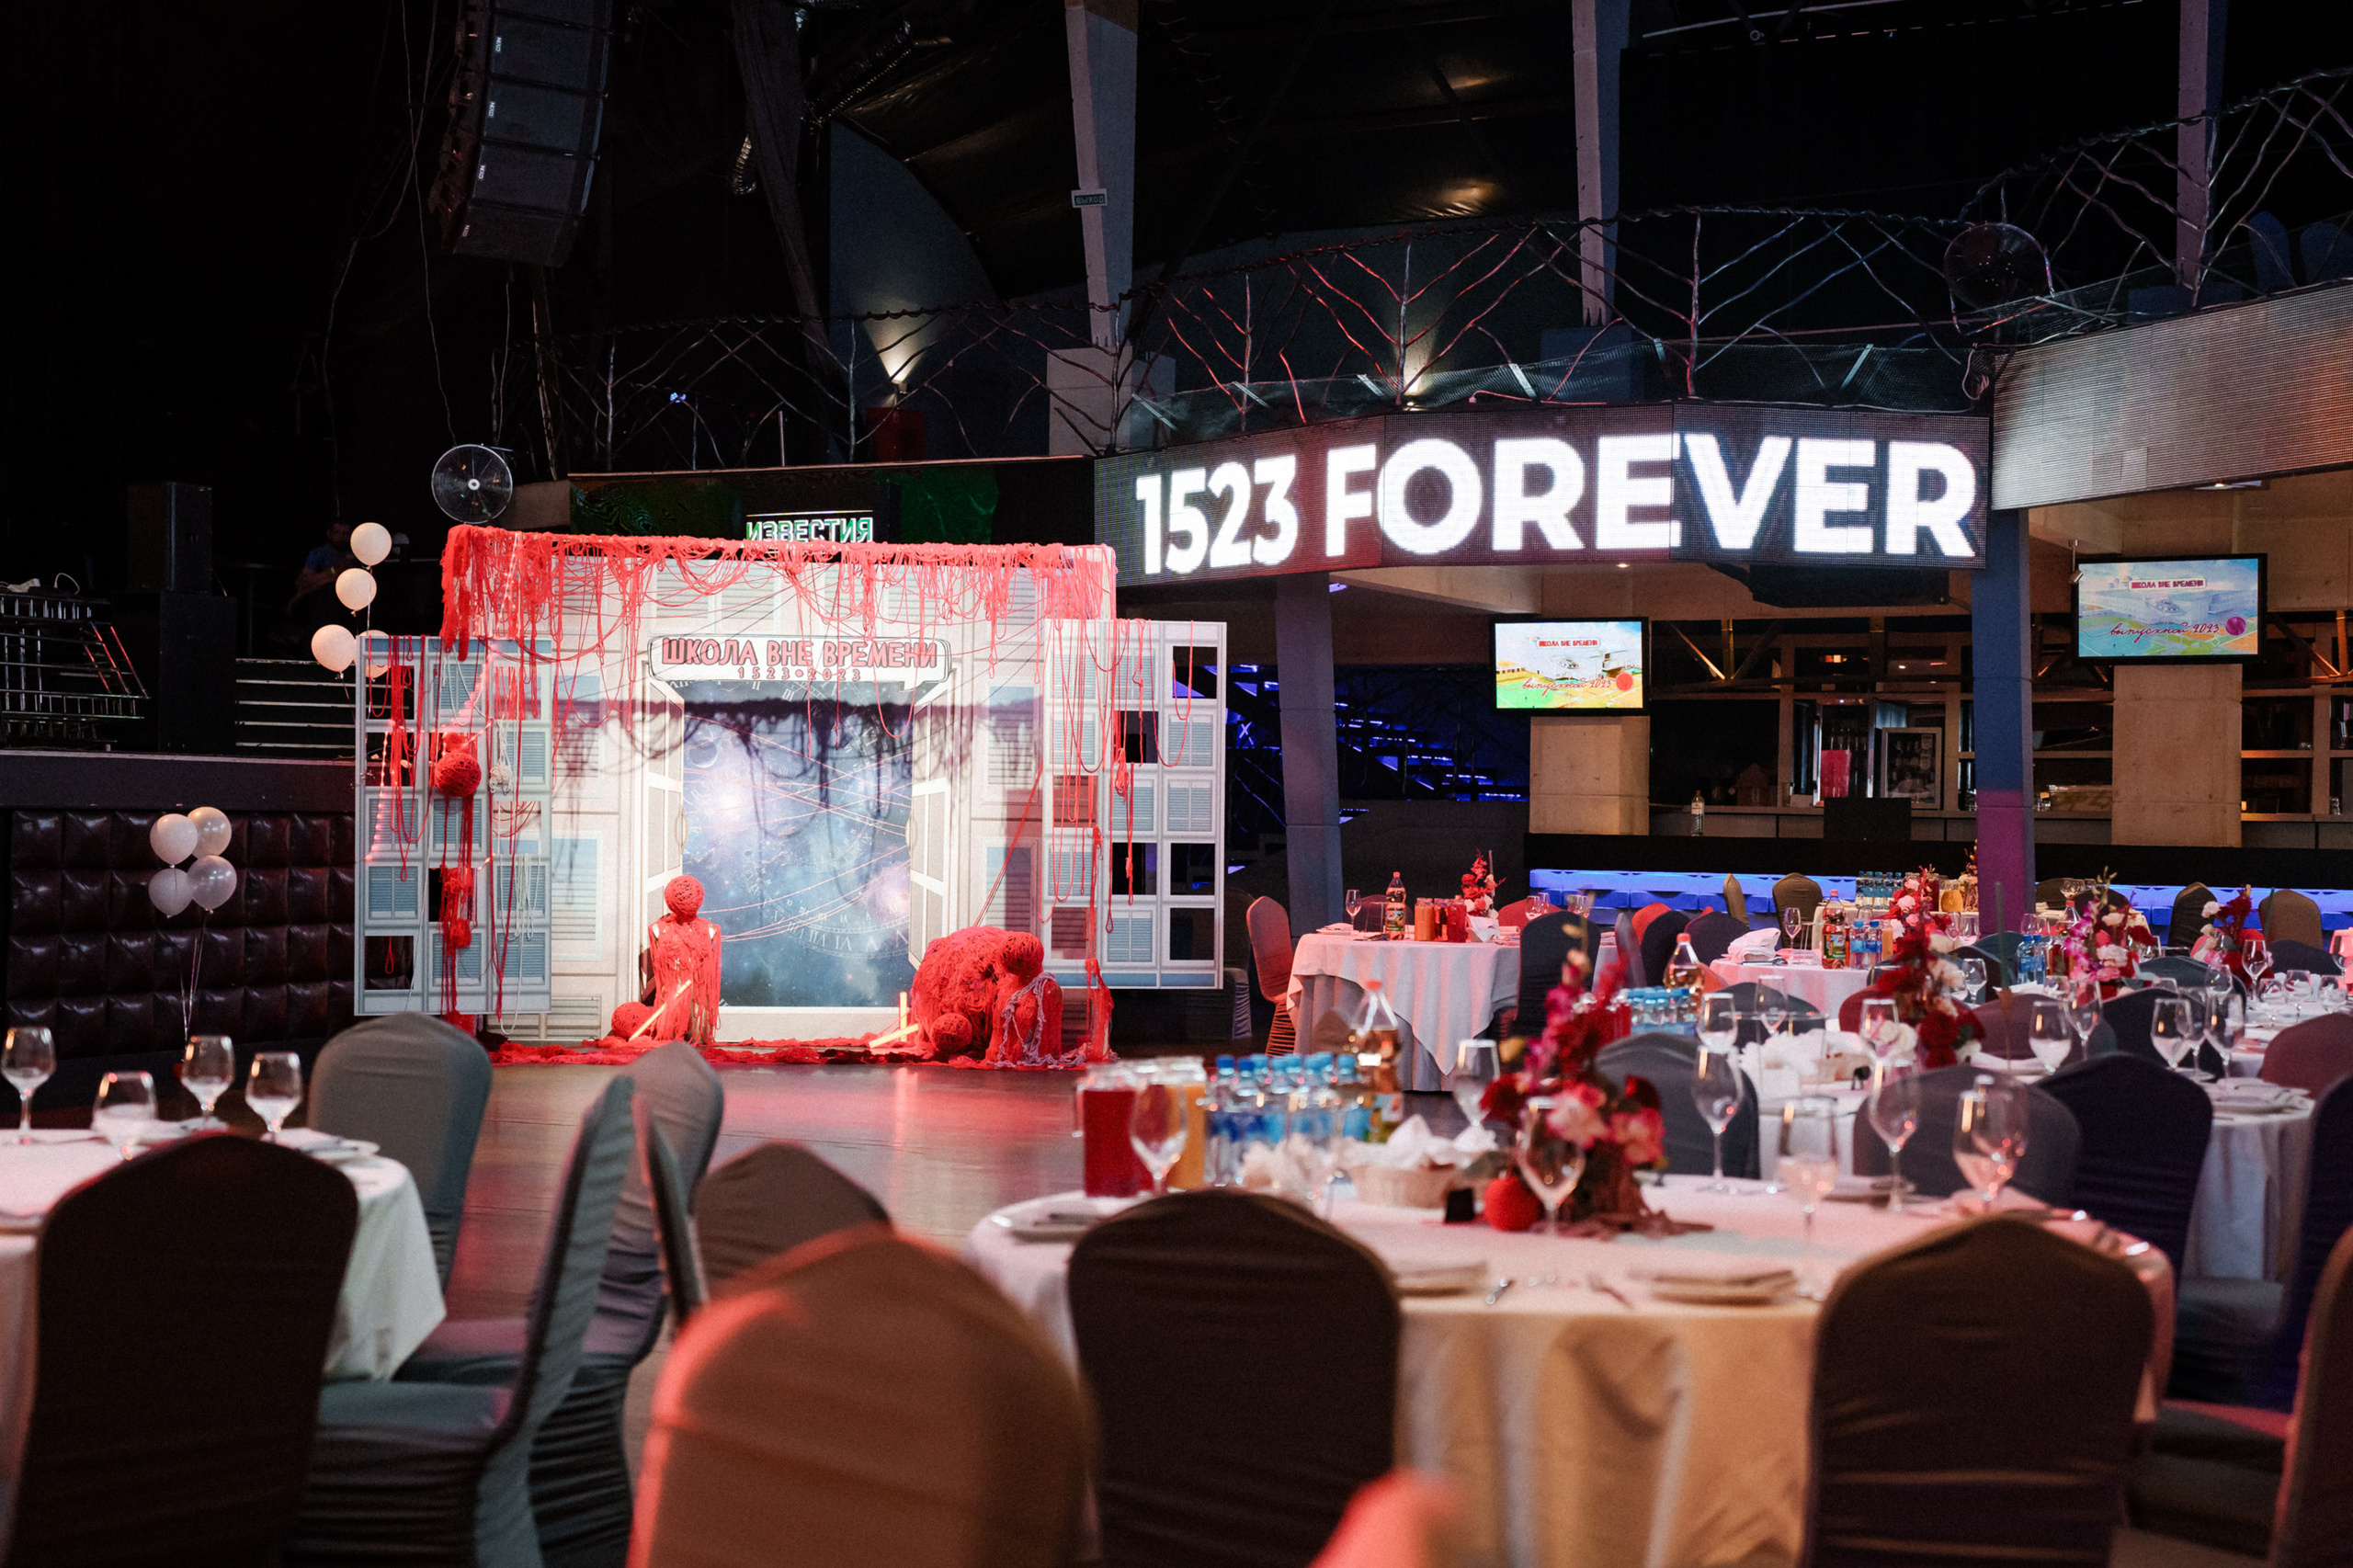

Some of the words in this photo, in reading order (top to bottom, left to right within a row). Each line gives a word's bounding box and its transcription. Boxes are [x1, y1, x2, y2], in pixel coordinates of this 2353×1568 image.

[1075, 195, 1104, 204] ВЫХОД
[1135, 454, 1299, 574] 1523
[1324, 433, 1976, 558] FOREVER
[745, 517, 873, 544] ИЗВЕСТИЯ
[2110, 621, 2188, 643] выпускной
[2192, 623, 2220, 634] 2023
[661, 637, 757, 666] ШКОЛА
[766, 639, 814, 667] ВНЕ
[823, 641, 938, 669] ВРЕМЕНИ
[737, 665, 790, 680] 1523
[1522, 677, 1586, 697] выпускной
[1589, 679, 1612, 689] 2023
